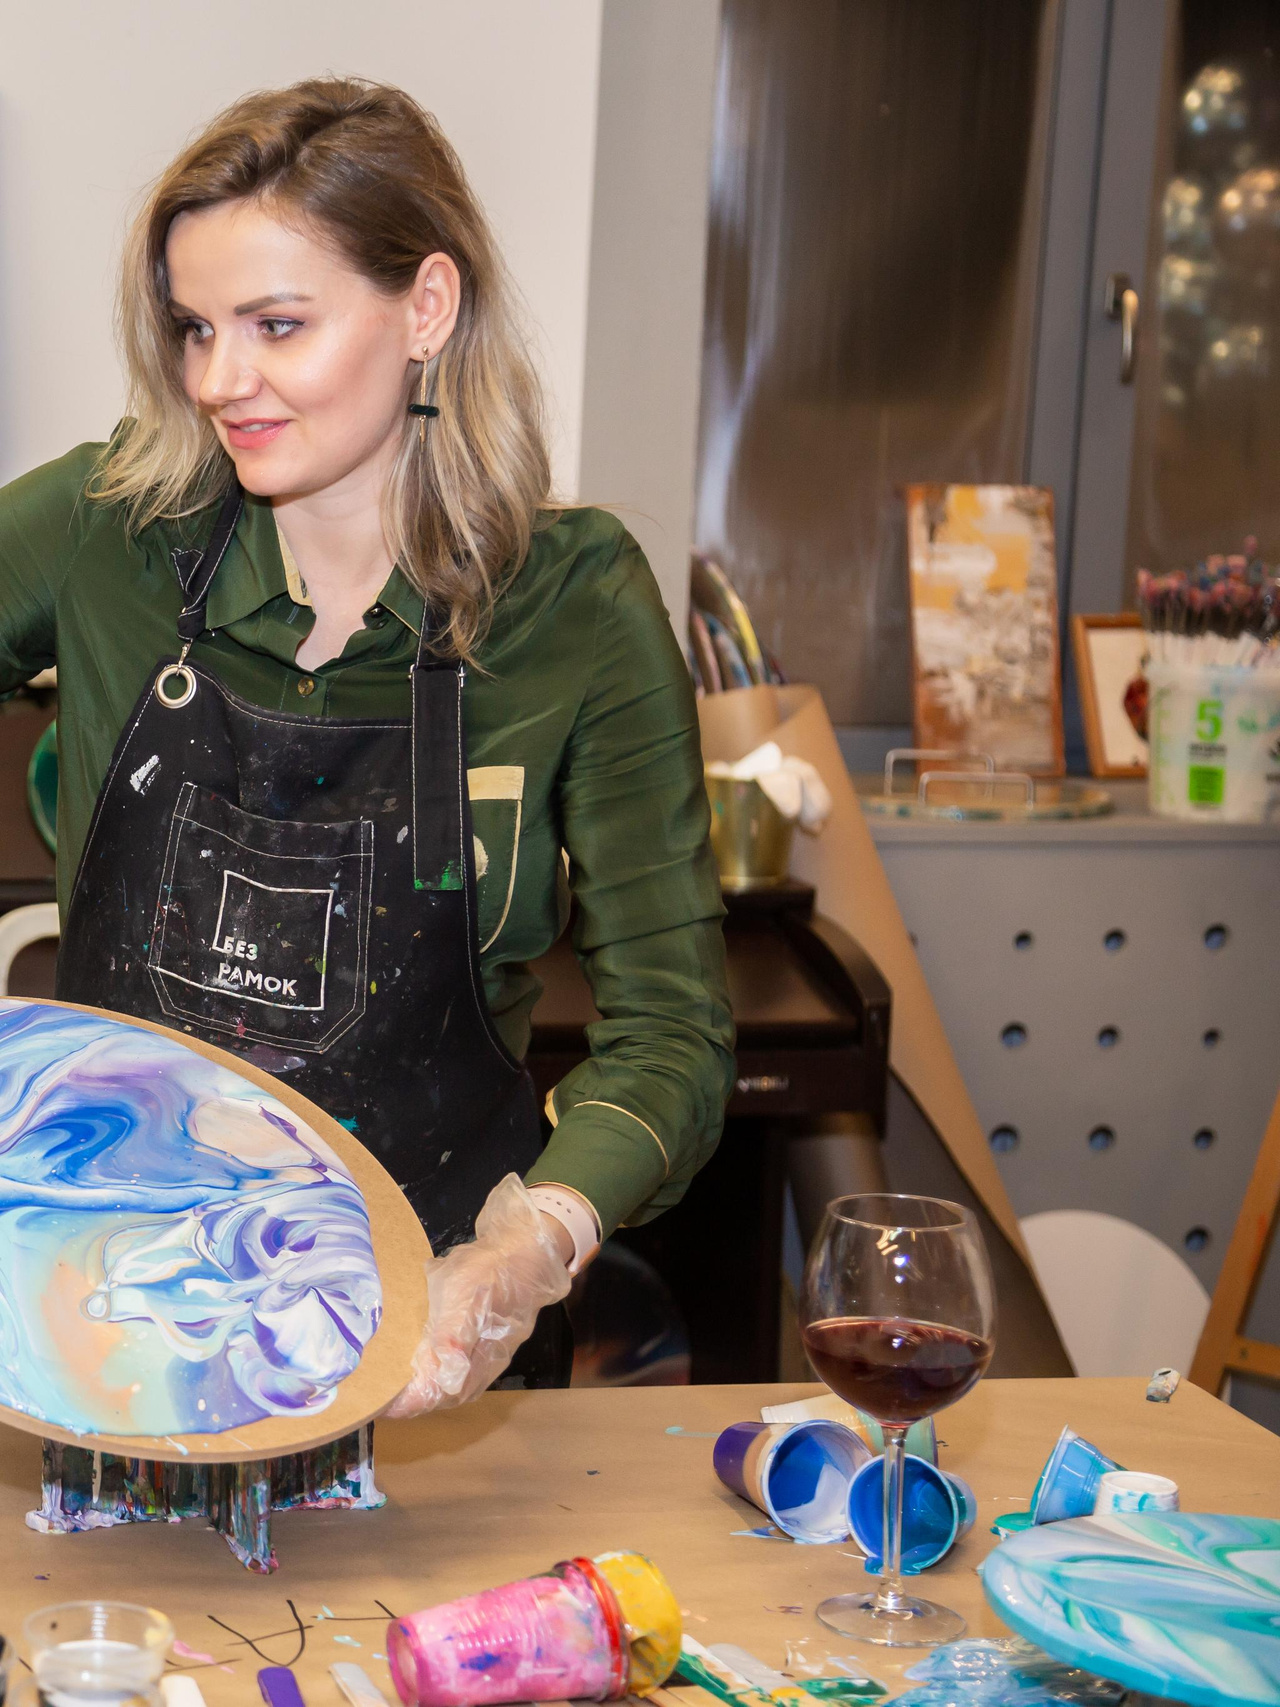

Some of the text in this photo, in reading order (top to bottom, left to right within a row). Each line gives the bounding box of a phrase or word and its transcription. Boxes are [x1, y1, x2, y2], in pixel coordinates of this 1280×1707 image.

[1196, 699, 1224, 741] 5
[223, 935, 258, 961] БЕЗ
[218, 962, 297, 996] РАМОК
